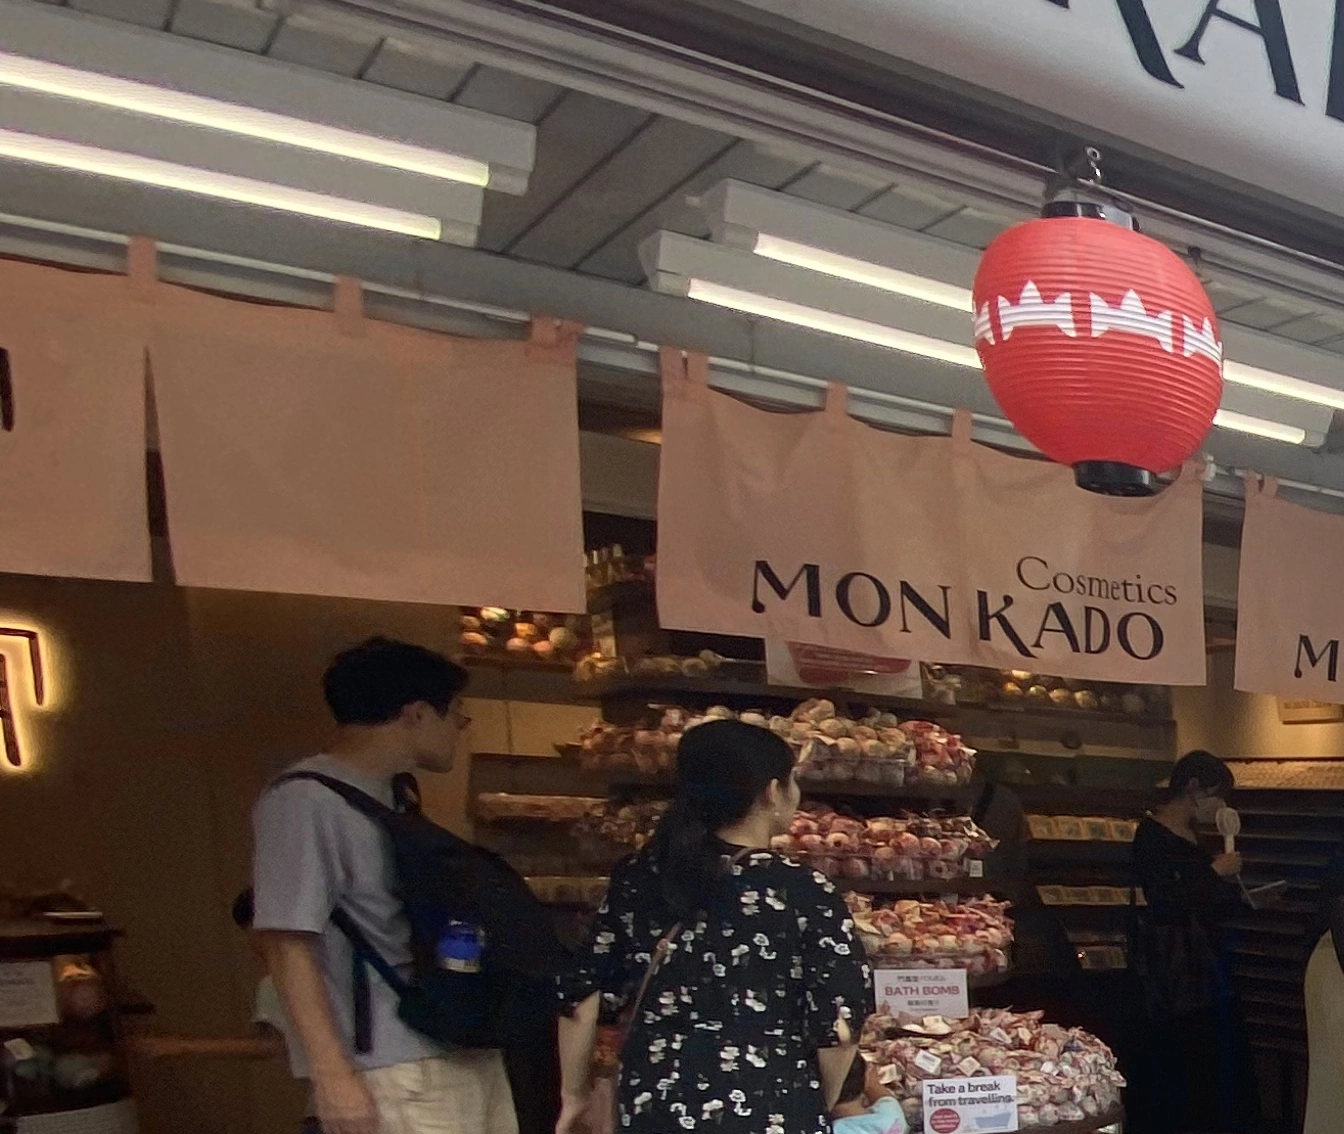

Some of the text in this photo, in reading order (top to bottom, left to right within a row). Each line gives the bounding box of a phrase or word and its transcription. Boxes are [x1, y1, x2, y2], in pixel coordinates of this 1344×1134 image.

[1016, 555, 1178, 606] Cosmetics
[751, 560, 1165, 660] MON KADO
[885, 985, 960, 996] BATH BOMB
[927, 1081, 1001, 1094] Take a break
[928, 1094, 1014, 1108] from travelling.
